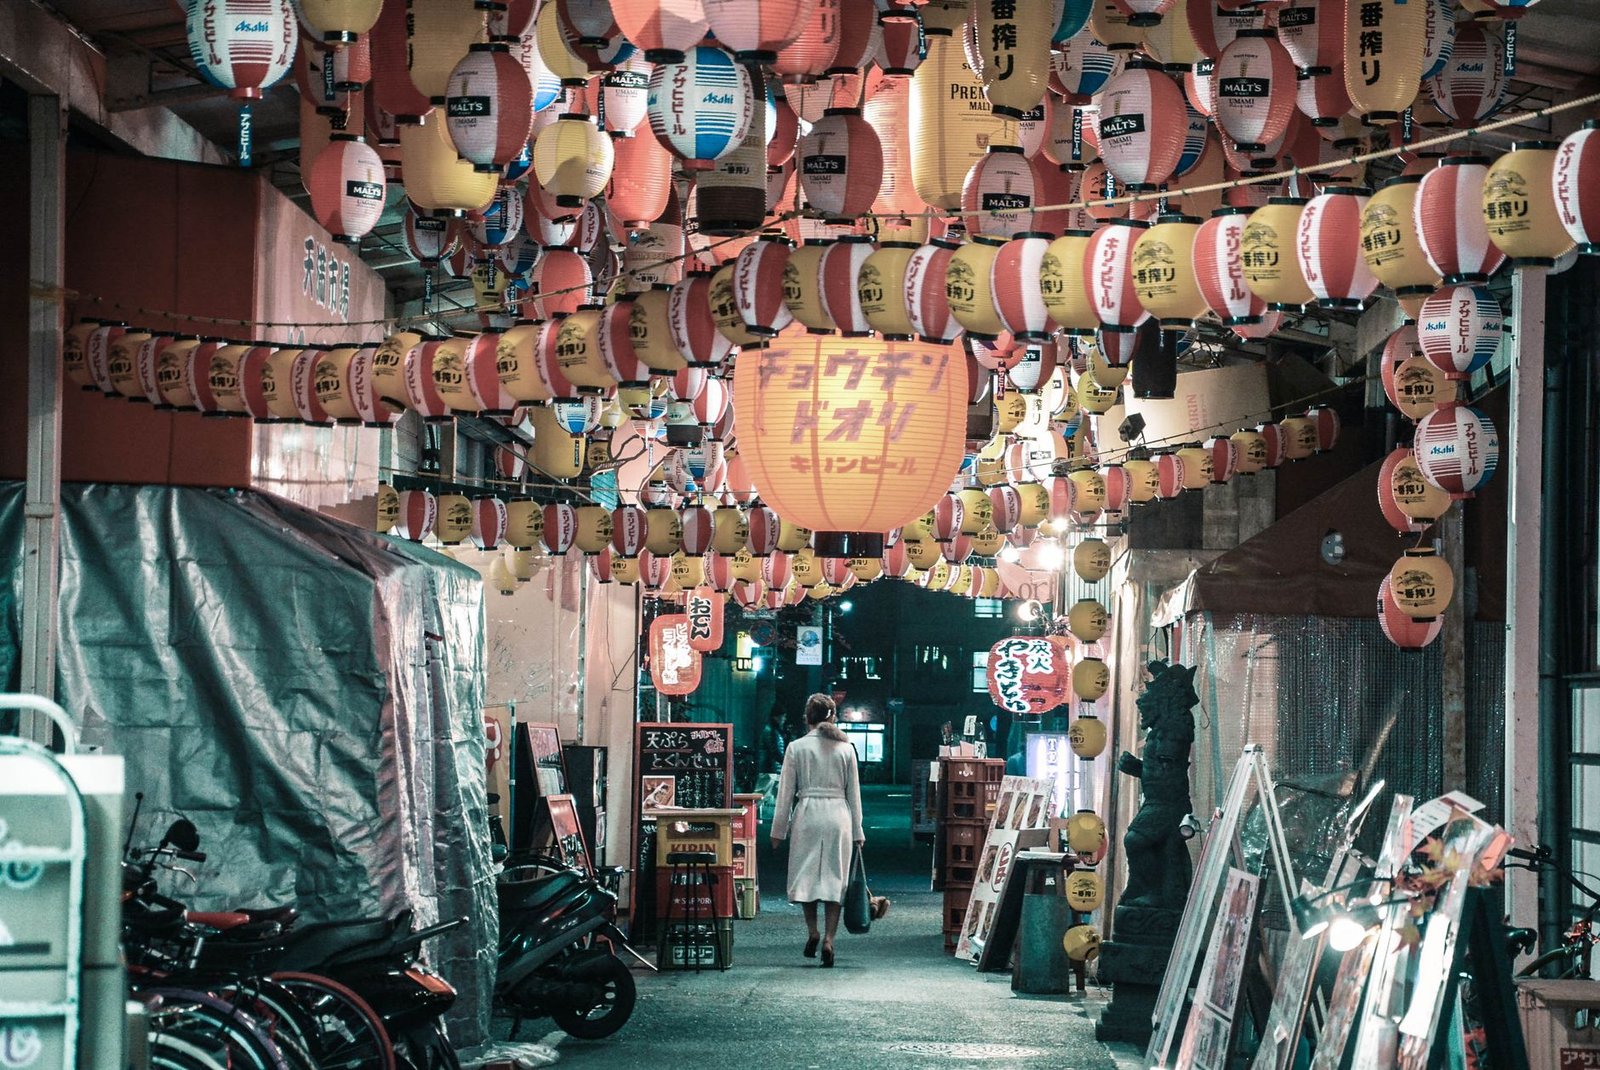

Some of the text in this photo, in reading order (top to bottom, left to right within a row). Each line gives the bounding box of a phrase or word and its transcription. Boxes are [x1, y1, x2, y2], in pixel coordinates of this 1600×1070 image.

[235, 21, 269, 32] Asahi
[1457, 63, 1483, 72] Asahi
[1506, 29, 1515, 71] アサヒビール
[611, 76, 645, 85] MALT'S
[703, 92, 734, 105] Asahi
[1225, 83, 1262, 92] MALT'S
[450, 101, 483, 112] MALT'S
[672, 65, 688, 135] アサヒビール
[240, 113, 250, 160] アサヒビール
[1103, 120, 1137, 132] MALT'S
[720, 163, 750, 174] 一番搾り
[806, 161, 838, 170] MALT'S
[1557, 141, 1576, 225] キリンビール
[353, 186, 382, 196] MALT'S
[989, 199, 1024, 208] MALT'S
[1300, 206, 1317, 281] キリンビール
[740, 248, 757, 310] キリンビール
[1101, 238, 1120, 309] キリンビール
[1225, 226, 1245, 300] キリンビール
[905, 255, 924, 321] キリンビール
[672, 287, 686, 348] キリンビール
[1425, 321, 1446, 330] Asahi
[1457, 300, 1470, 353] アサヒビール
[294, 356, 307, 411] キリンビール
[354, 356, 368, 411] キリンビール
[406, 350, 422, 405] キリンビール
[1397, 384, 1434, 395] 一番搾り
[790, 400, 919, 445] ドオリ
[790, 456, 917, 475] キリンビール
[1431, 444, 1454, 455] Asahi
[1464, 423, 1478, 475] アサヒビール
[561, 509, 570, 546] キリンビール
[627, 511, 636, 547] キリンビール
[1397, 587, 1435, 598] 一番搾り
[690, 597, 711, 640] おでん
[1029, 640, 1049, 671] 炭火
[646, 731, 689, 749] 天ぷら
